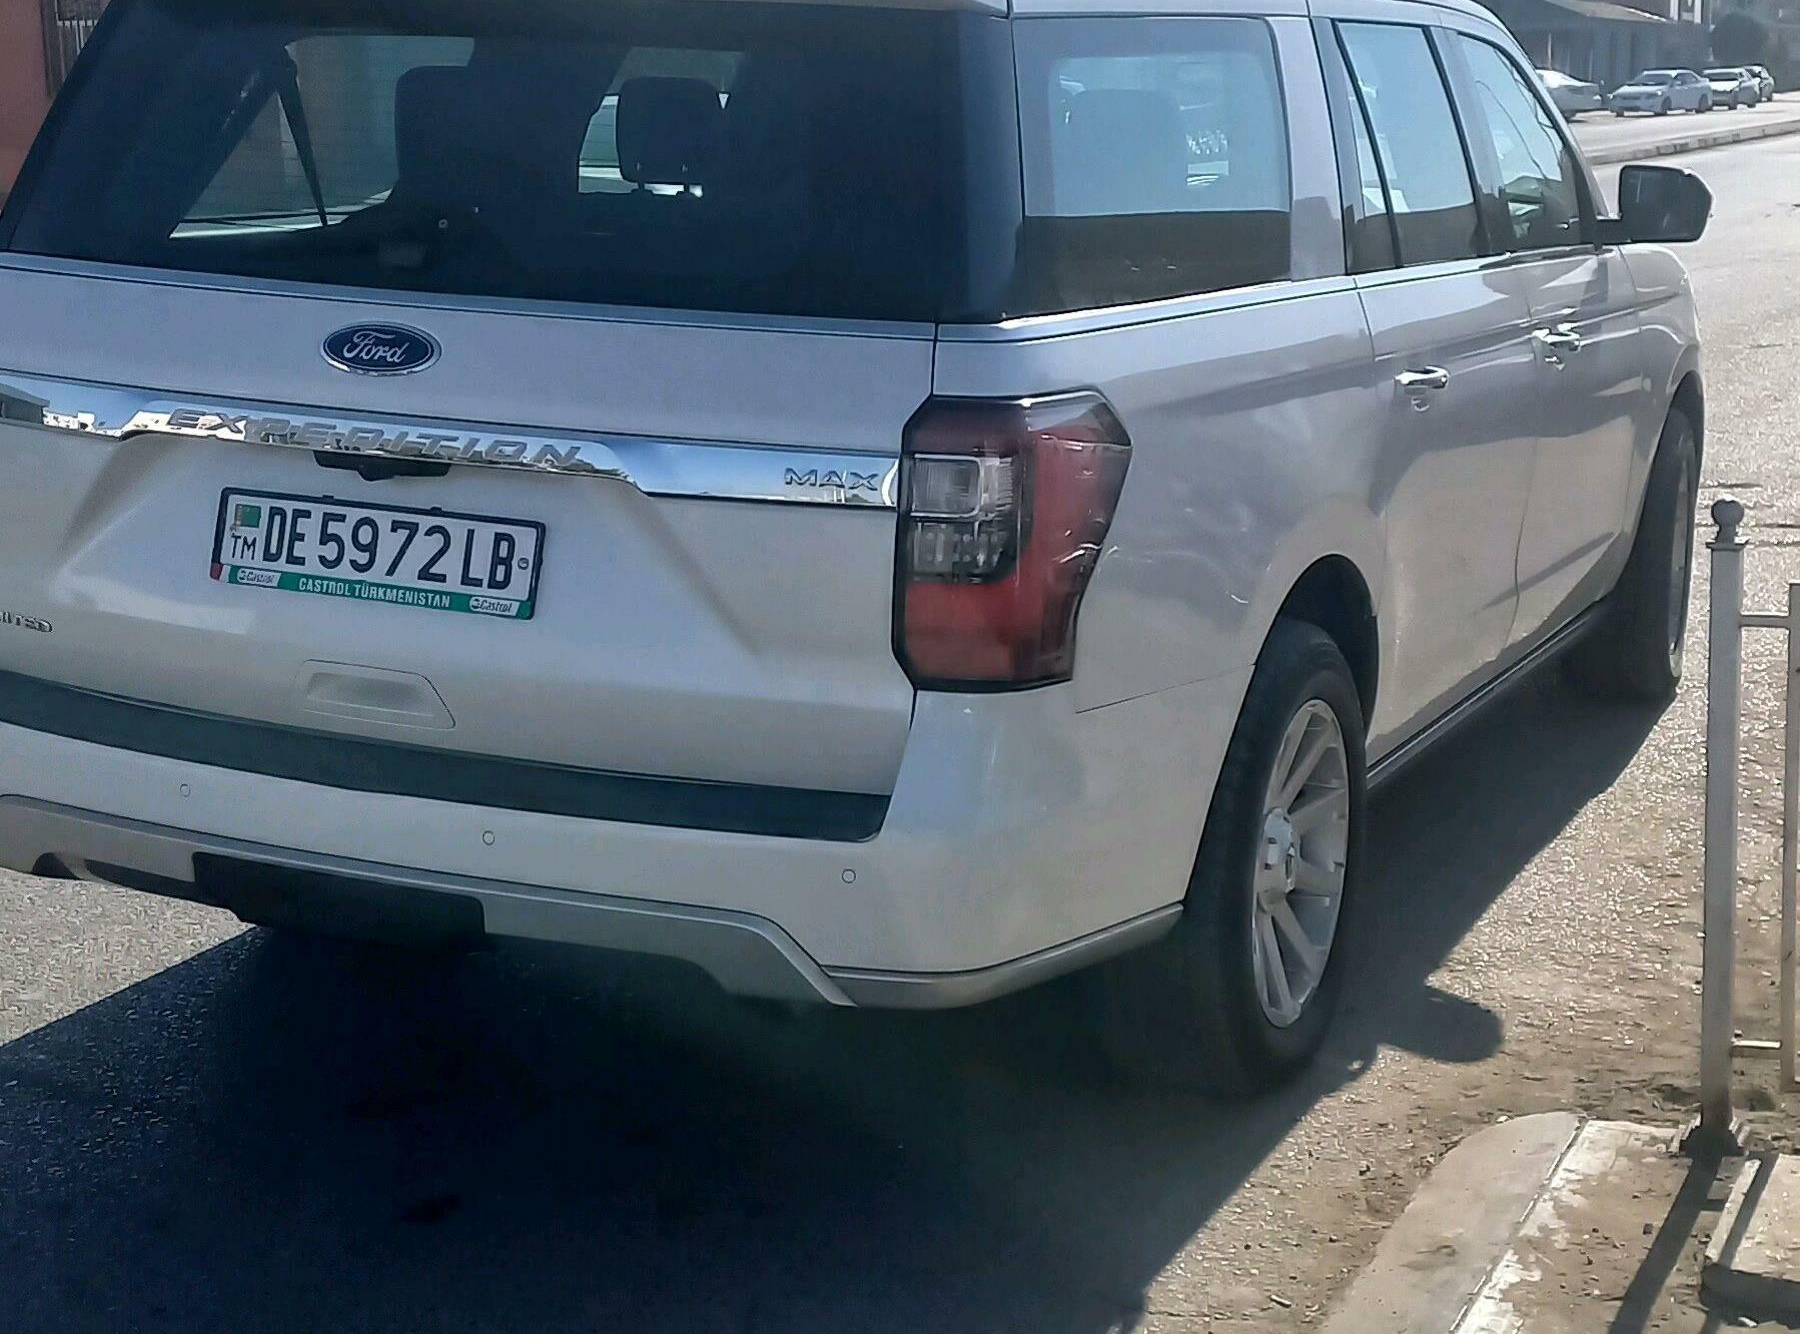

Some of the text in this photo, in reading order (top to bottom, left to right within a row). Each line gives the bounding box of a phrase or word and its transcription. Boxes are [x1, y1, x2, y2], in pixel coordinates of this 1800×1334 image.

[343, 330, 410, 362] Ford
[166, 408, 584, 467] EXPEDITION
[784, 467, 879, 491] MAX
[231, 533, 256, 560] TM
[299, 577, 351, 597] CASTROL
[479, 599, 514, 614] Castrol
